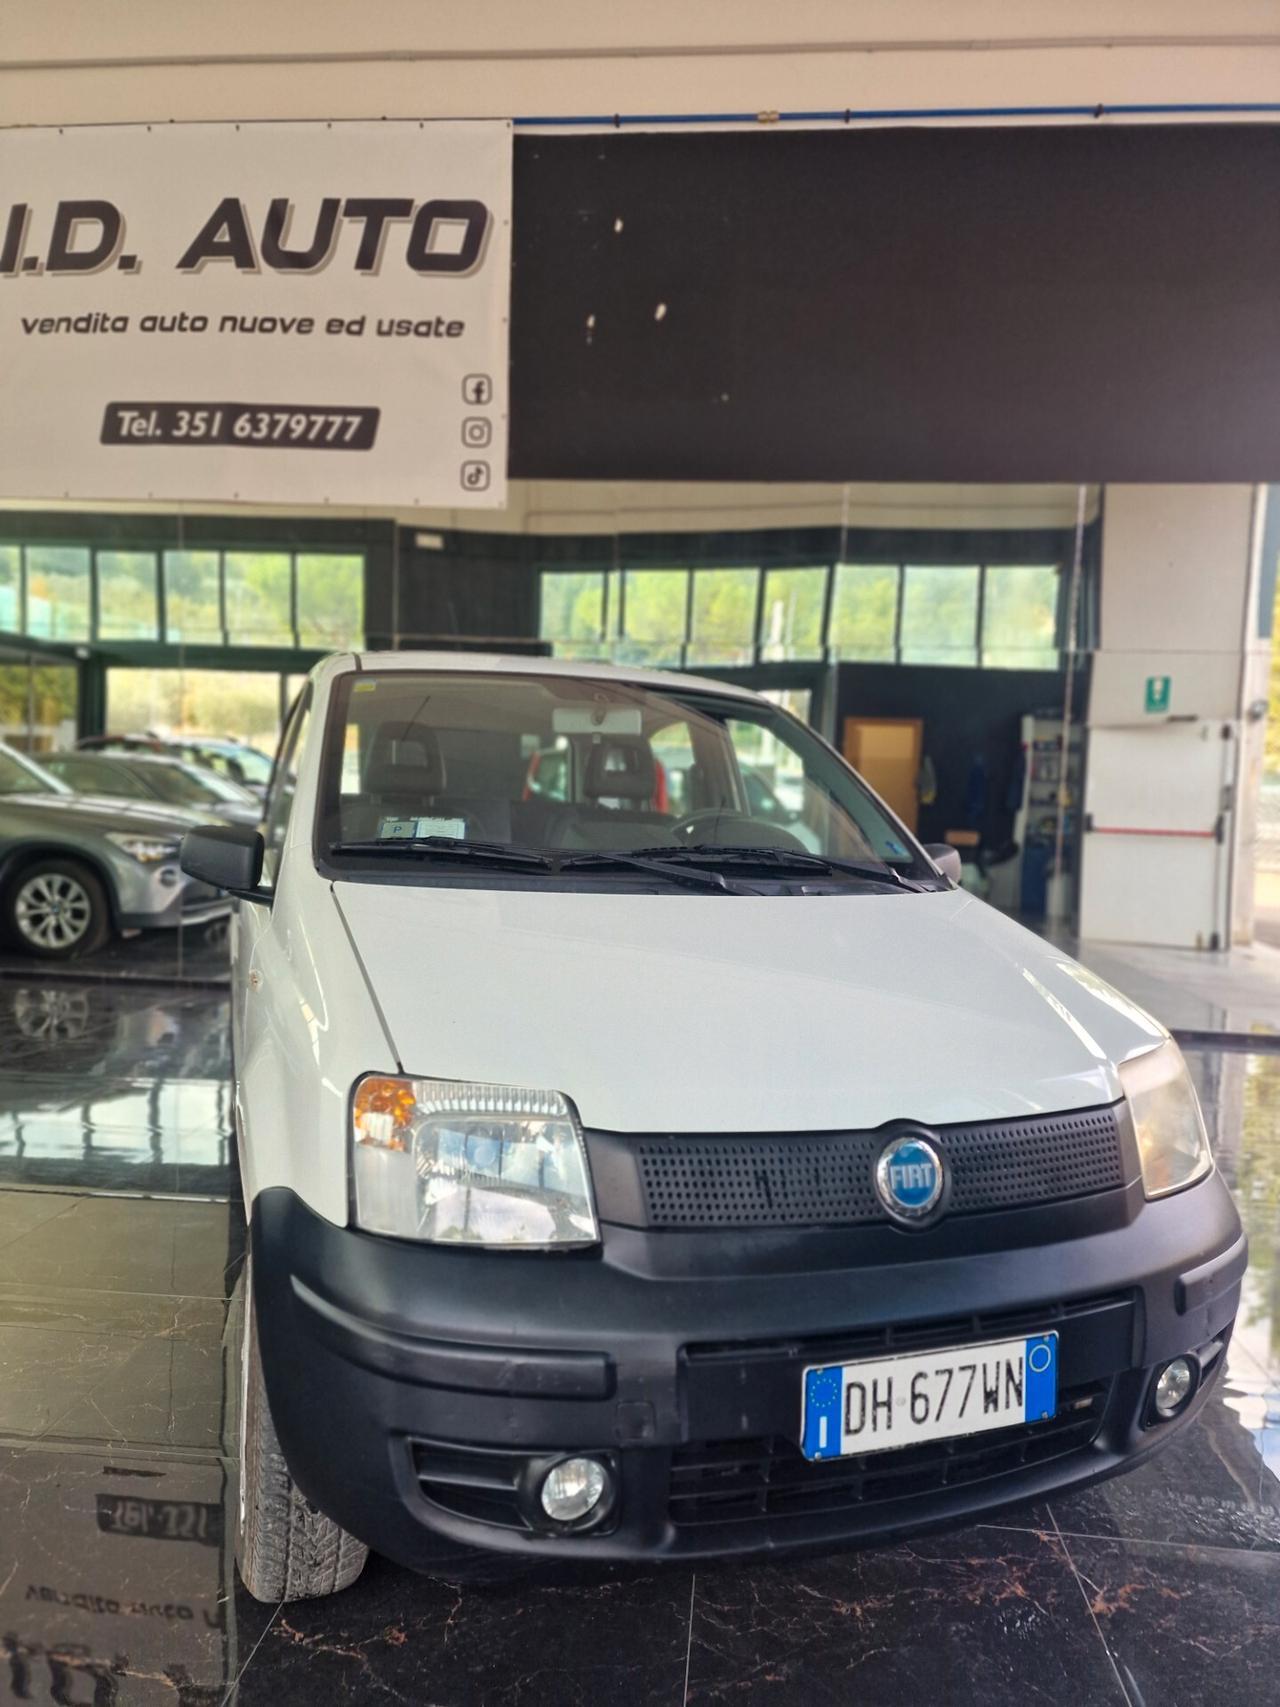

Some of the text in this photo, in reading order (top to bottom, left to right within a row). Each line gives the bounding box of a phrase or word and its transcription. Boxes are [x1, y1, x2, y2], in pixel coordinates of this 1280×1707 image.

[175, 198, 493, 278] AUTO
[21, 312, 465, 338] vendita auto nuove ed usate
[117, 410, 362, 442] Tel. 351 6379777
[890, 1163, 932, 1190] FIAT
[844, 1356, 1024, 1436] DH 677WN
